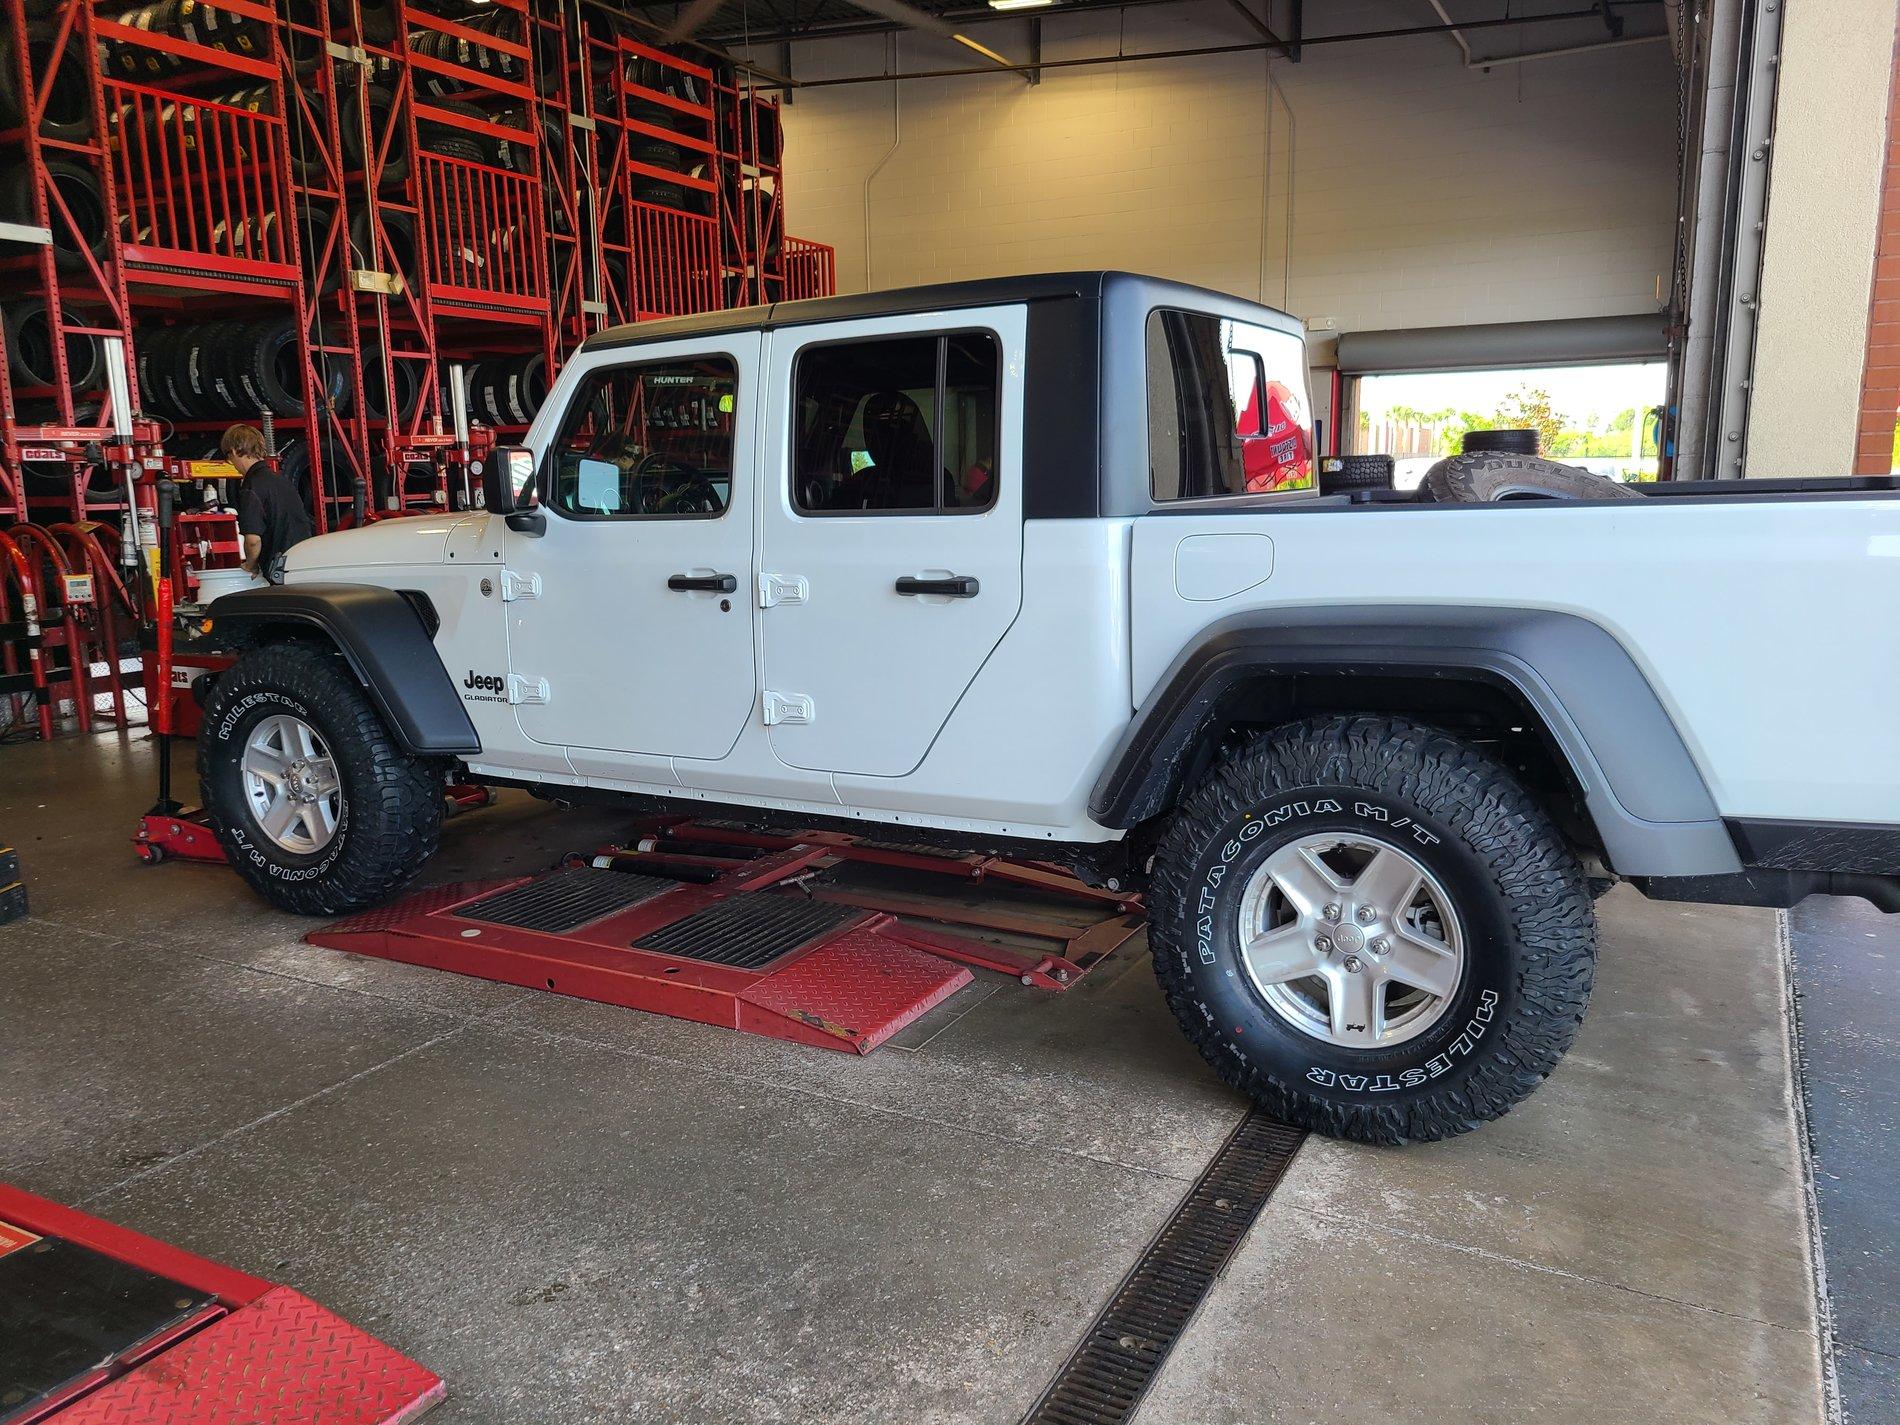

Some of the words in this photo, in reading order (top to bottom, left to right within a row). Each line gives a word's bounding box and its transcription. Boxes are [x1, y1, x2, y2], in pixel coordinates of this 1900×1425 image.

[653, 376, 694, 384] HUNTER
[464, 670, 504, 694] Jeep
[464, 693, 508, 703] GLADIATOR
[218, 692, 308, 740] MILESTAR
[231, 827, 266, 868] M/T
[269, 800, 349, 881] PATAGONIA
[1196, 799, 1343, 965] PATAGONIA
[1354, 802, 1440, 845] M/T
[1306, 989, 1499, 1092] MILESTAR
